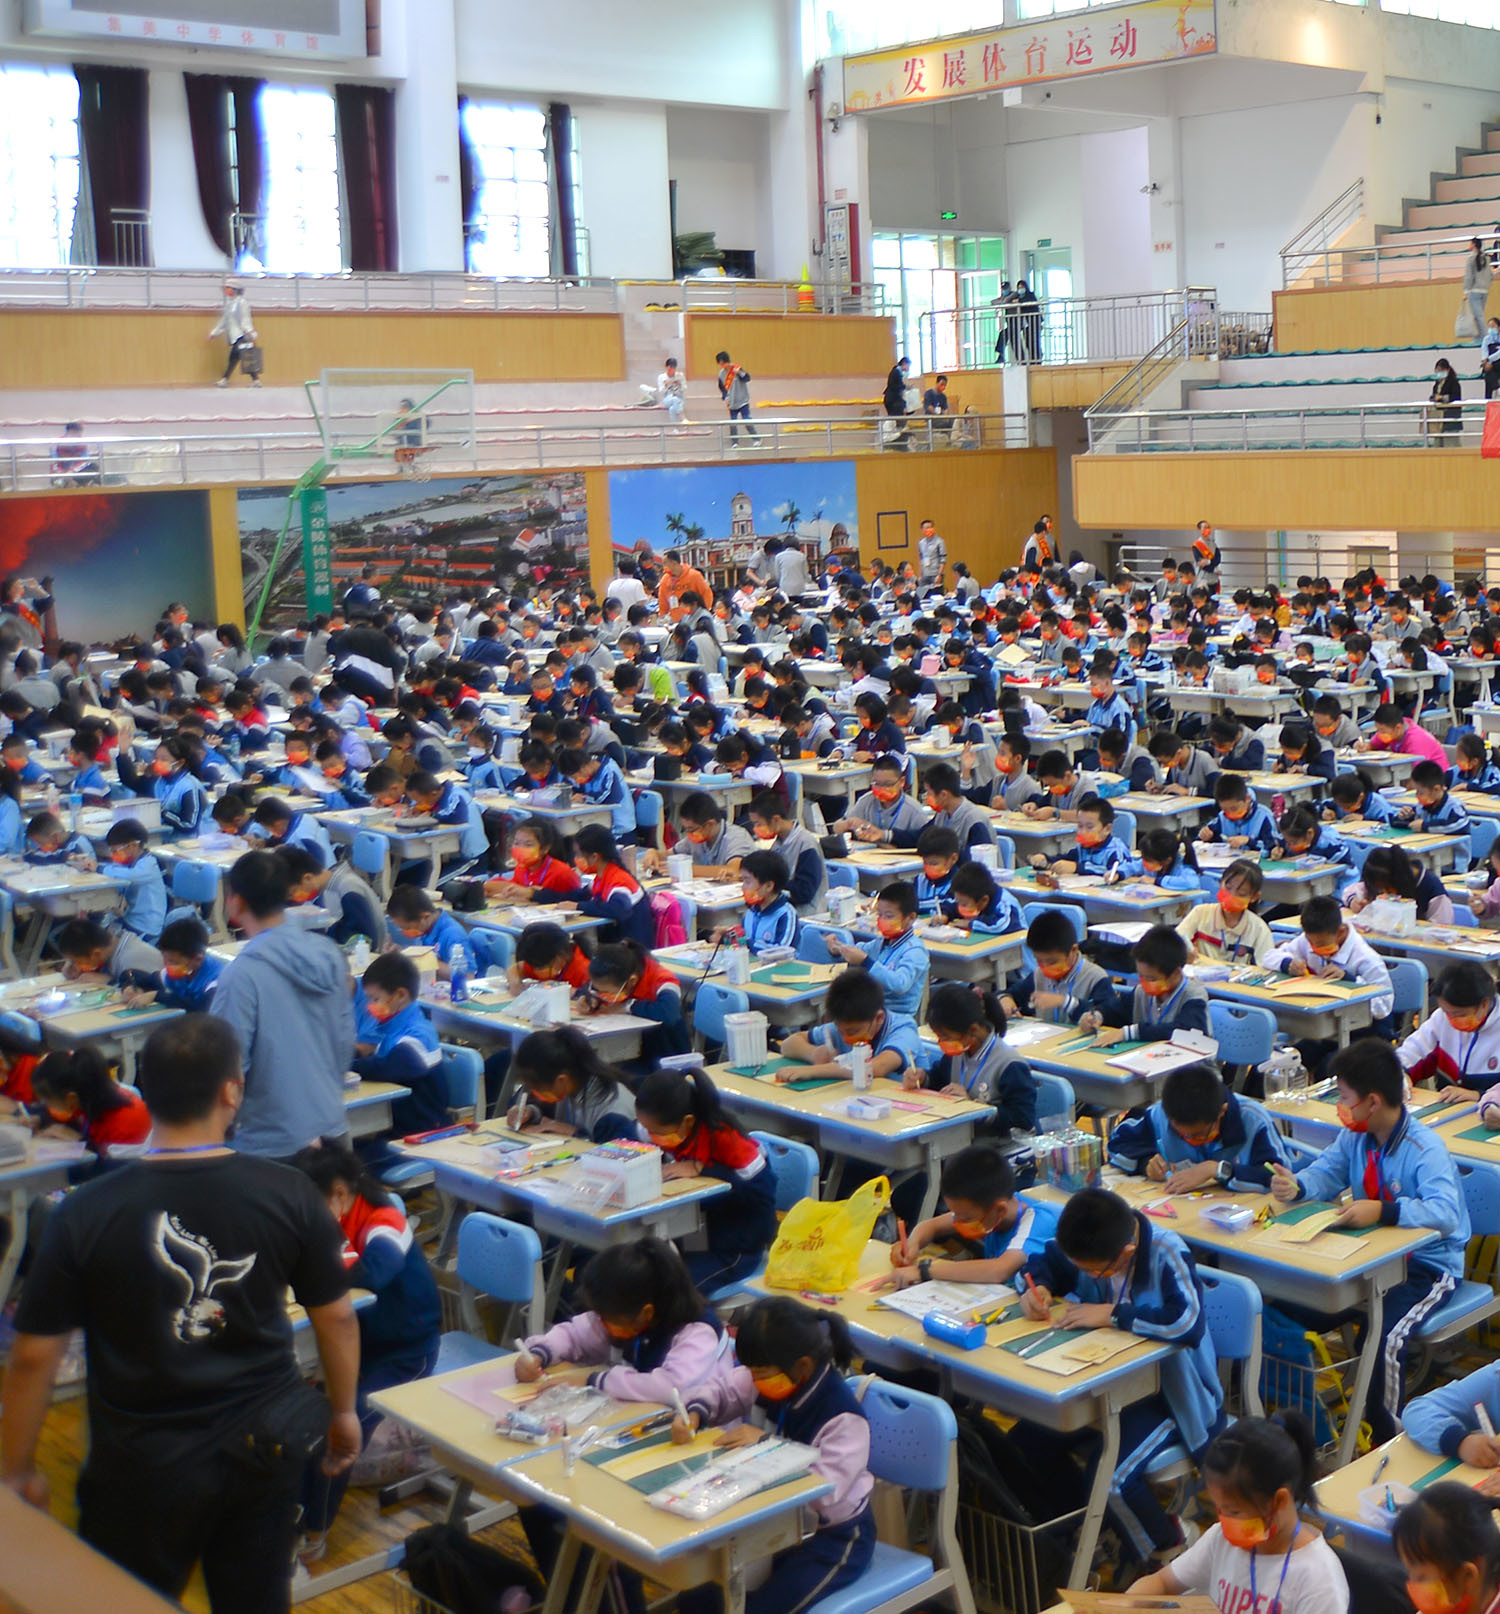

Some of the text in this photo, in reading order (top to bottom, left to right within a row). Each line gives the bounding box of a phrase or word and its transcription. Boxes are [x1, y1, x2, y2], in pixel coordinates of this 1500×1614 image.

[107, 15, 320, 50] 集美中学体育馆
[902, 18, 1138, 96] 发展体育运动
